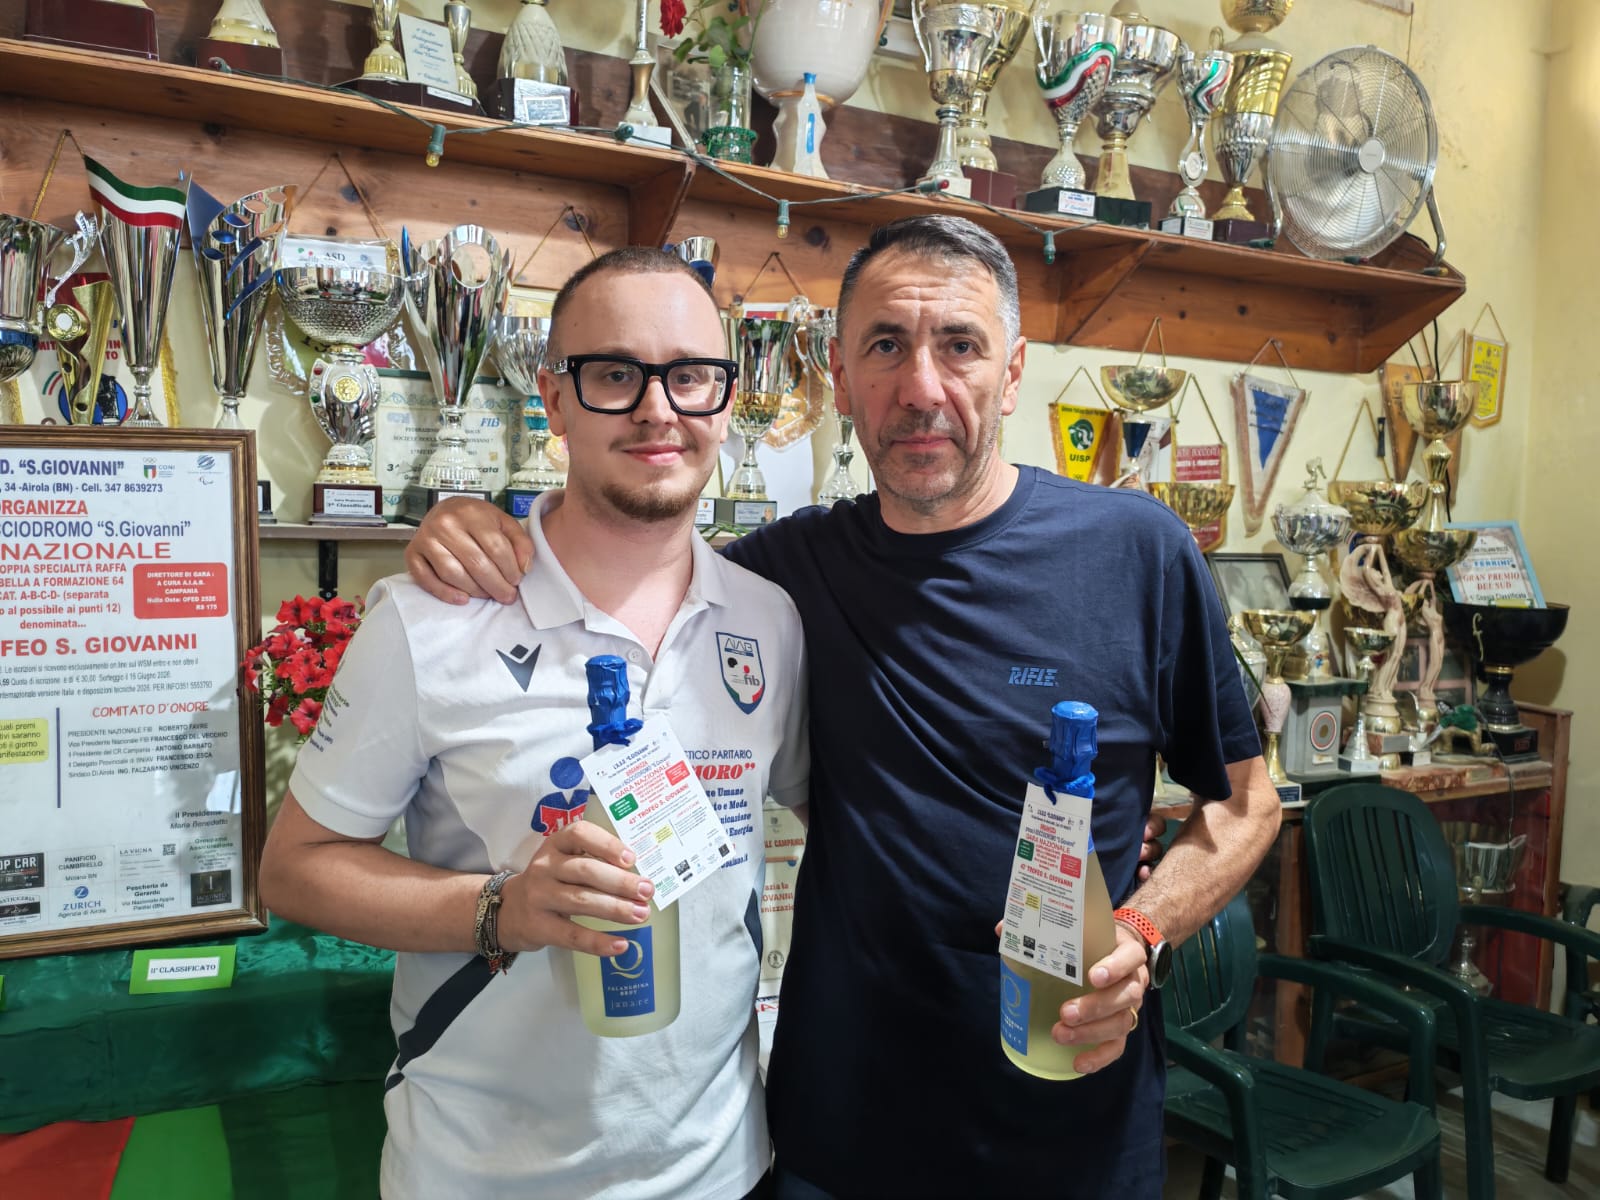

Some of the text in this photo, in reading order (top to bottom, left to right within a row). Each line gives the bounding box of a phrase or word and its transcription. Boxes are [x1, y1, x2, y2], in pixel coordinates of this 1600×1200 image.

[1069, 454, 1091, 462] UISP
[4, 482, 16, 492] 34
[52, 482, 73, 494] (BN)
[81, 483, 102, 492] Cell.
[105, 483, 122, 492] 347
[124, 483, 163, 493] 8639273
[0, 500, 88, 515] RGANIZZA
[0, 520, 93, 538] CIODROMO
[1, 542, 171, 560] NAZIONALE
[95, 563, 127, 573] RAFFA
[33, 577, 40, 587] A
[43, 576, 110, 586] FORMAZIONE
[112, 576, 124, 586] 64
[1463, 572, 1520, 582] GRAN PREMIO
[63, 589, 109, 601] (separata
[8, 605, 17, 615] al
[20, 604, 64, 616] possibile
[67, 604, 76, 614] ai
[78, 603, 103, 615] punti
[106, 602, 121, 614] 12)
[1, 633, 197, 657] FEO S. GIOVANNI
[1008, 667, 1058, 687] RIFLE
[92, 704, 155, 718] COMITATO
[16, 723, 36, 731] premi
[159, 724, 188, 732] ROBERTO
[12, 732, 41, 740] saranno
[151, 734, 188, 743] FRANCESCO
[15, 740, 38, 749] giorno
[155, 744, 182, 752] ANTONIO
[157, 753, 194, 761] FRANCESCO
[712, 749, 752, 760] PARITARIO
[169, 762, 201, 771] VINCENZO
[717, 788, 744, 796] Umane
[728, 799, 748, 810] Moda
[729, 825, 754, 837] Energia
[15, 856, 37, 869] CAR
[64, 854, 97, 863] PANIFICIO
[58, 860, 103, 871] CIAMBRIELLO
[63, 900, 102, 911] ZURICH
[58, 911, 81, 919] Agenzia
[160, 964, 217, 974] CLASSIFICATO
